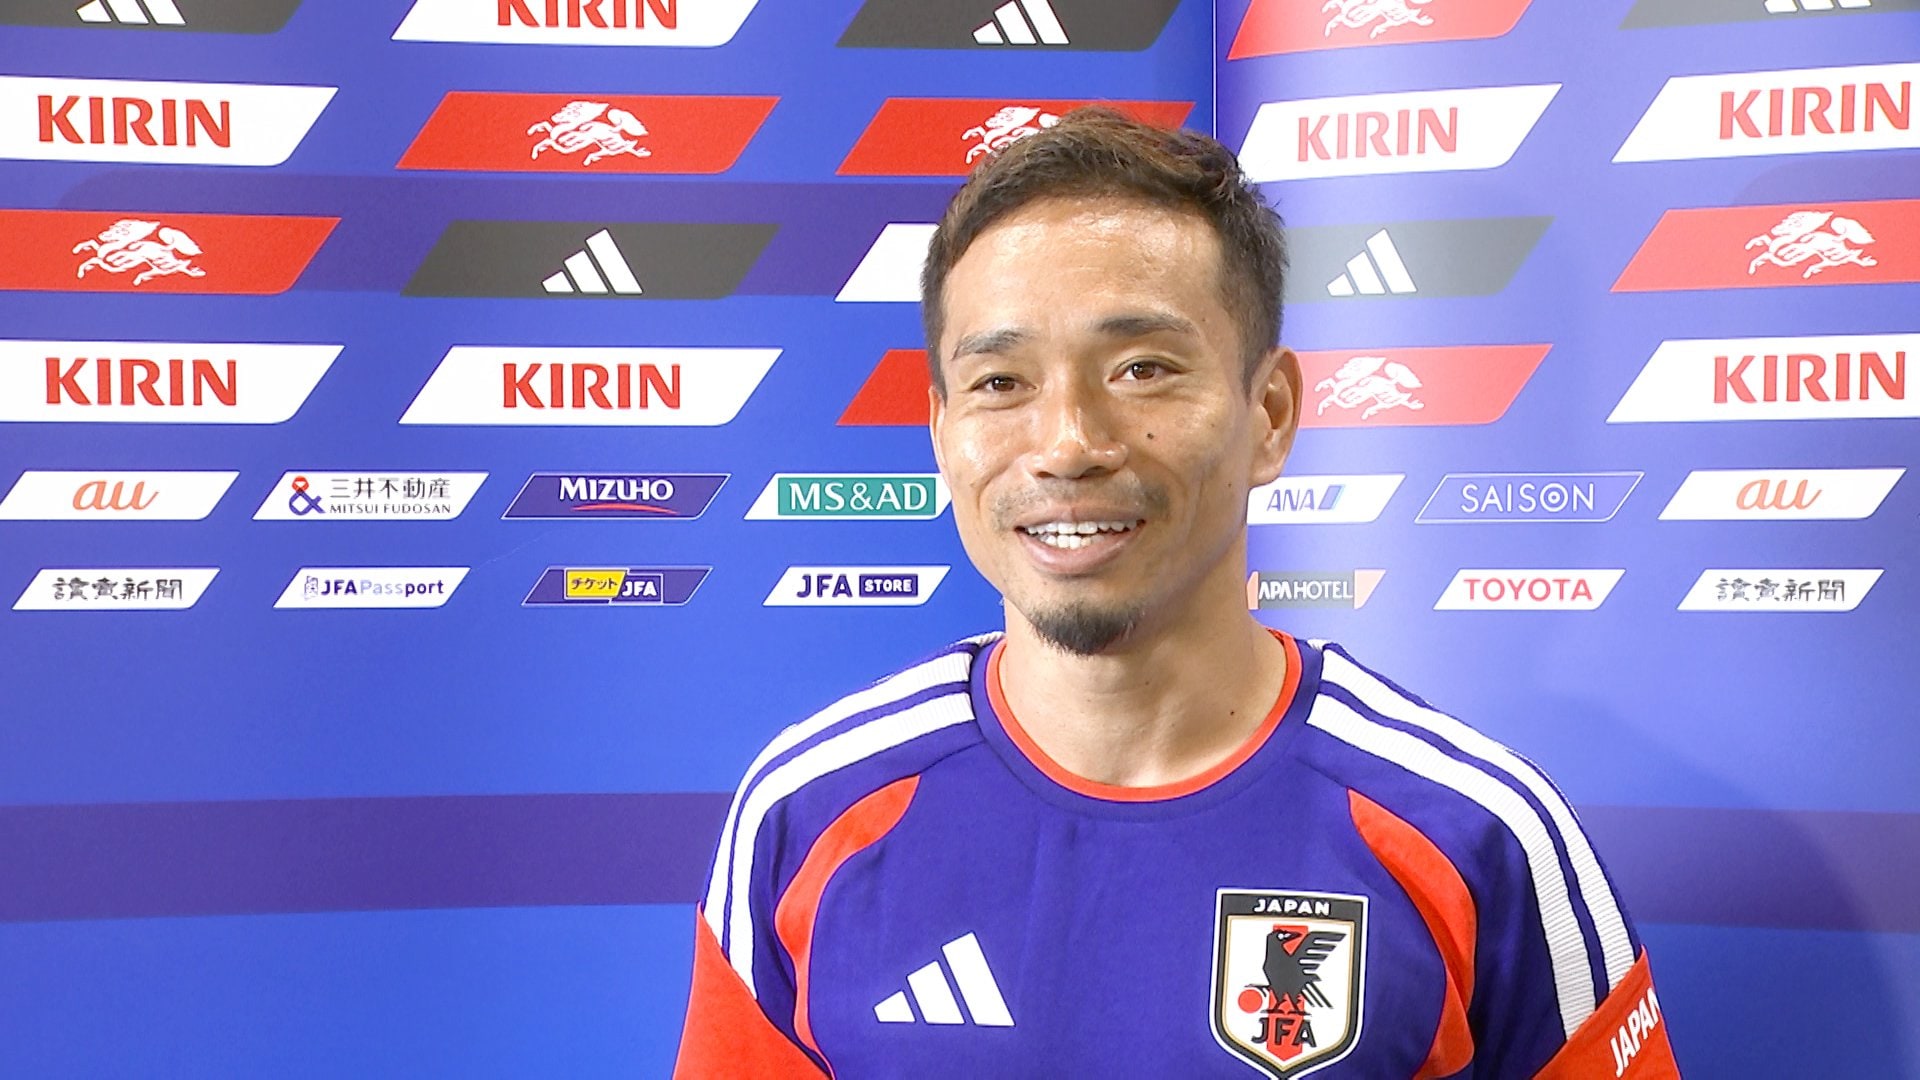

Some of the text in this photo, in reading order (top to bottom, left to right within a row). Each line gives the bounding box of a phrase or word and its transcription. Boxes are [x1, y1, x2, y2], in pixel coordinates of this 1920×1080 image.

[37, 95, 231, 148] KIRIN
[1718, 81, 1911, 140] KIRIN
[1297, 107, 1458, 162] KIRIN
[45, 357, 238, 406] KIRIN
[502, 363, 681, 410] KIRIN
[1713, 351, 1906, 404] KIRIN
[72, 480, 160, 512] au
[329, 477, 451, 500] 三井不動産
[559, 477, 674, 501] MIZUHO
[789, 483, 928, 511] MS&AD
[1266, 489, 1315, 512] ANA
[1460, 483, 1595, 513] SAISON
[1736, 479, 1823, 510] au
[329, 504, 451, 514] MITSUI FUDOSAN
[571, 577, 618, 590] チケット
[621, 581, 657, 597] JFA
[796, 574, 912, 599] JFA STORE
[1464, 578, 1593, 602] TOYOTA
[1252, 898, 1331, 917] JAPAN
[1251, 1017, 1317, 1049] JFA
